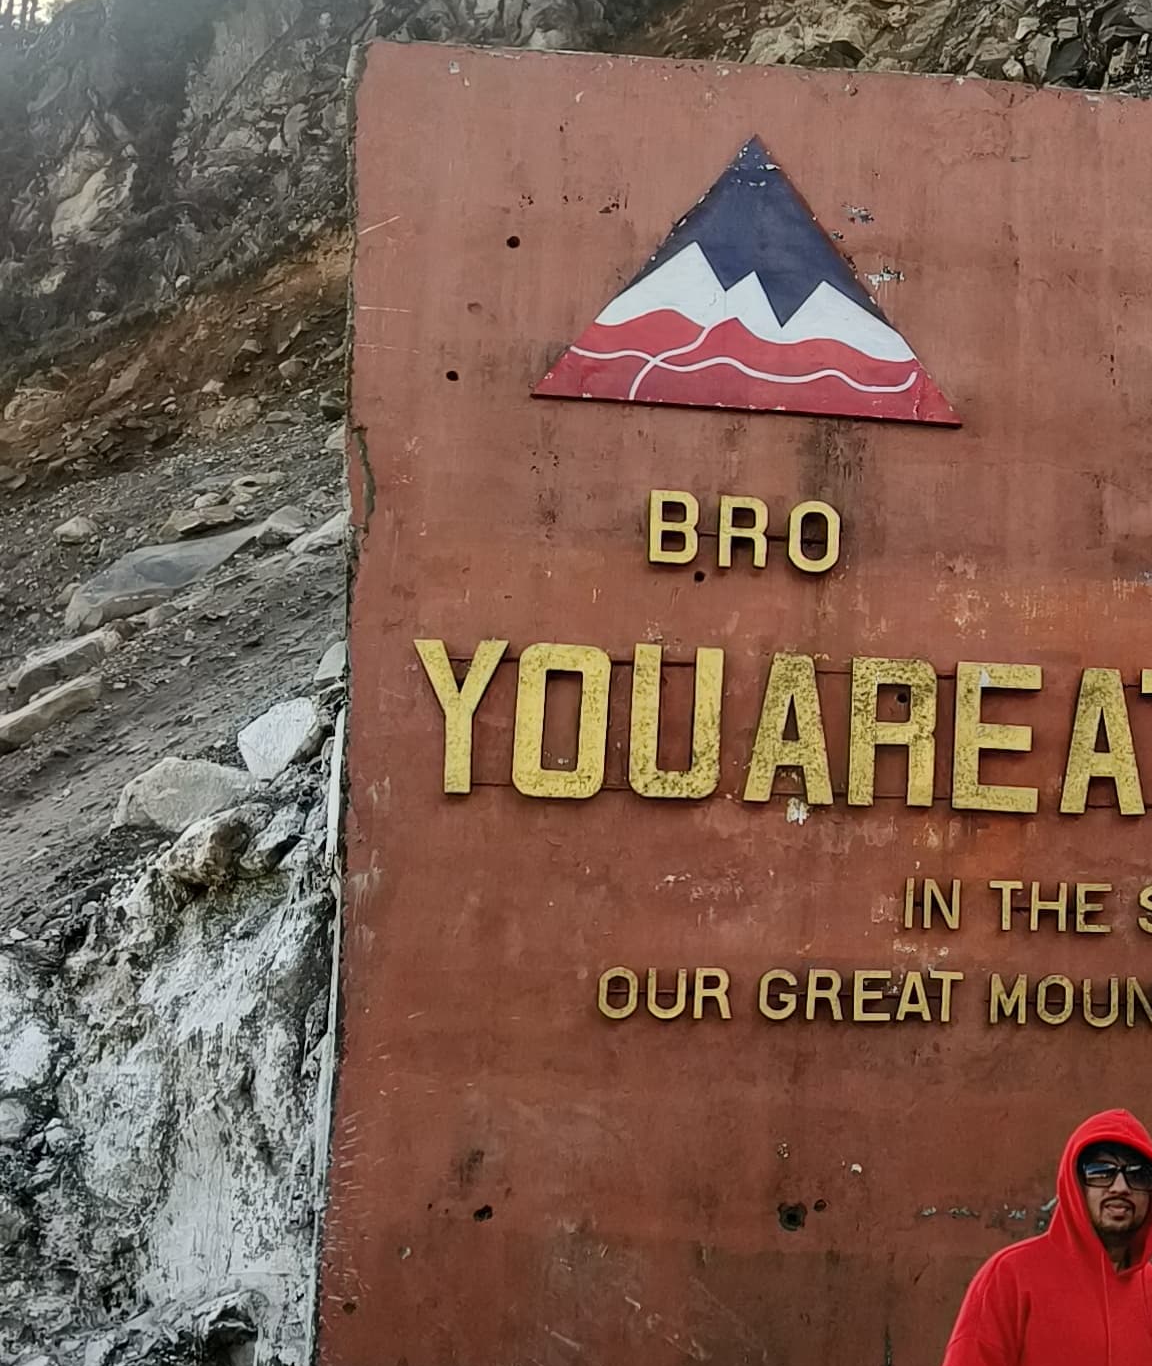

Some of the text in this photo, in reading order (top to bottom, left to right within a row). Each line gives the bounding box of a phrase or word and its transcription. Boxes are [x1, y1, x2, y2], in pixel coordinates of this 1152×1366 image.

[648, 489, 842, 573] BRO
[414, 638, 725, 800] YOU
[742, 652, 1044, 815] ARE
[902, 876, 962, 931] IN
[989, 879, 1113, 935] THE
[597, 966, 733, 1022] OUR
[757, 969, 964, 1025] GREAT
